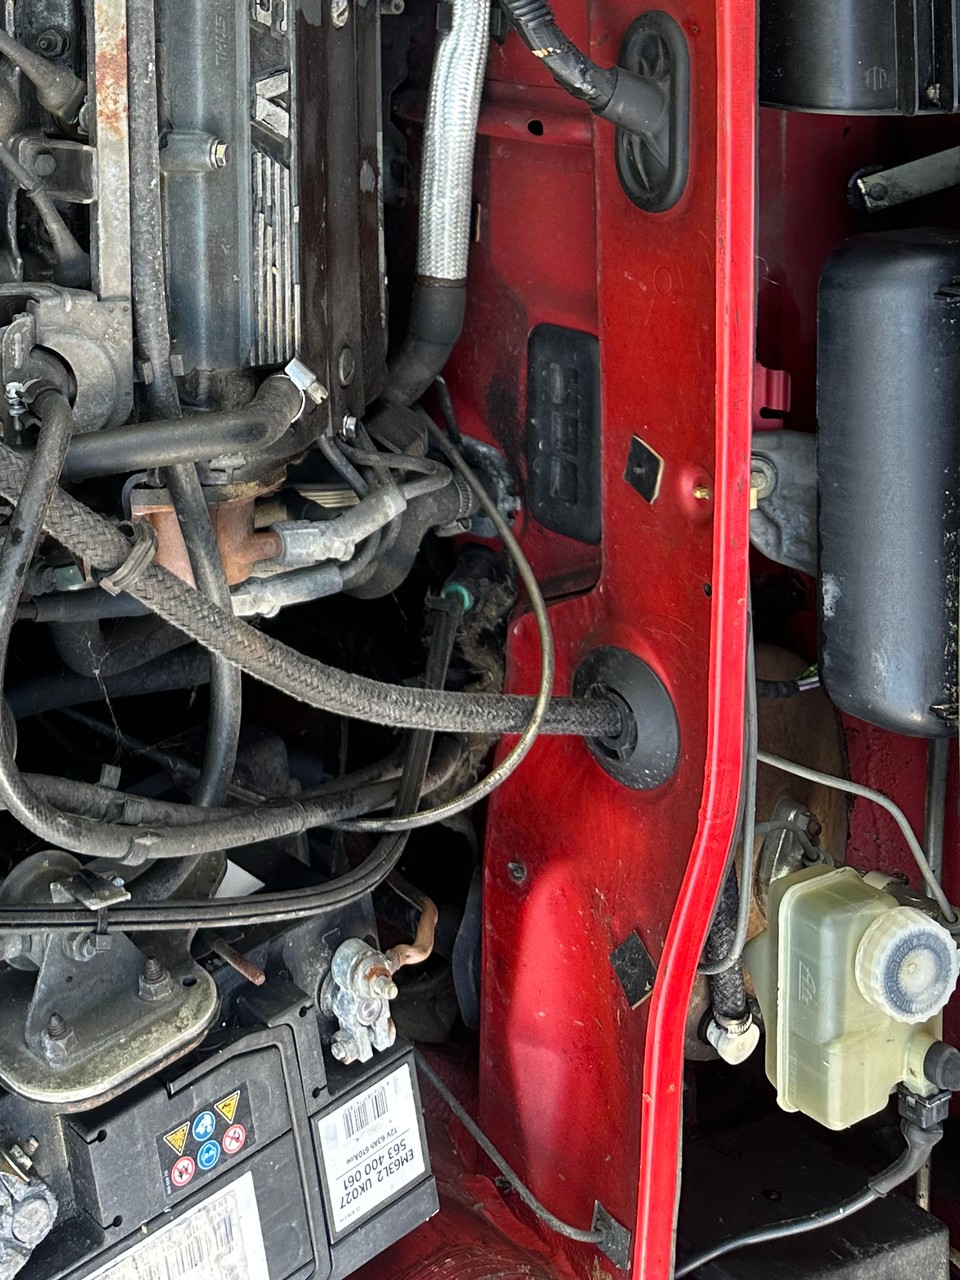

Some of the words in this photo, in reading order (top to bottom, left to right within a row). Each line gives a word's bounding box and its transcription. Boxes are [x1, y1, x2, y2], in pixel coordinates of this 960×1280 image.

[216, 14, 227, 66] STIHL
[254, 70, 290, 139] V
[370, 1135, 386, 1148] 63Ah
[386, 1127, 398, 1138] 12V
[387, 1138, 407, 1159] 563
[364, 1155, 384, 1175] 400
[376, 1148, 414, 1182] EM63L2
[343, 1170, 361, 1191] 061
[340, 1178, 372, 1209] UK027
